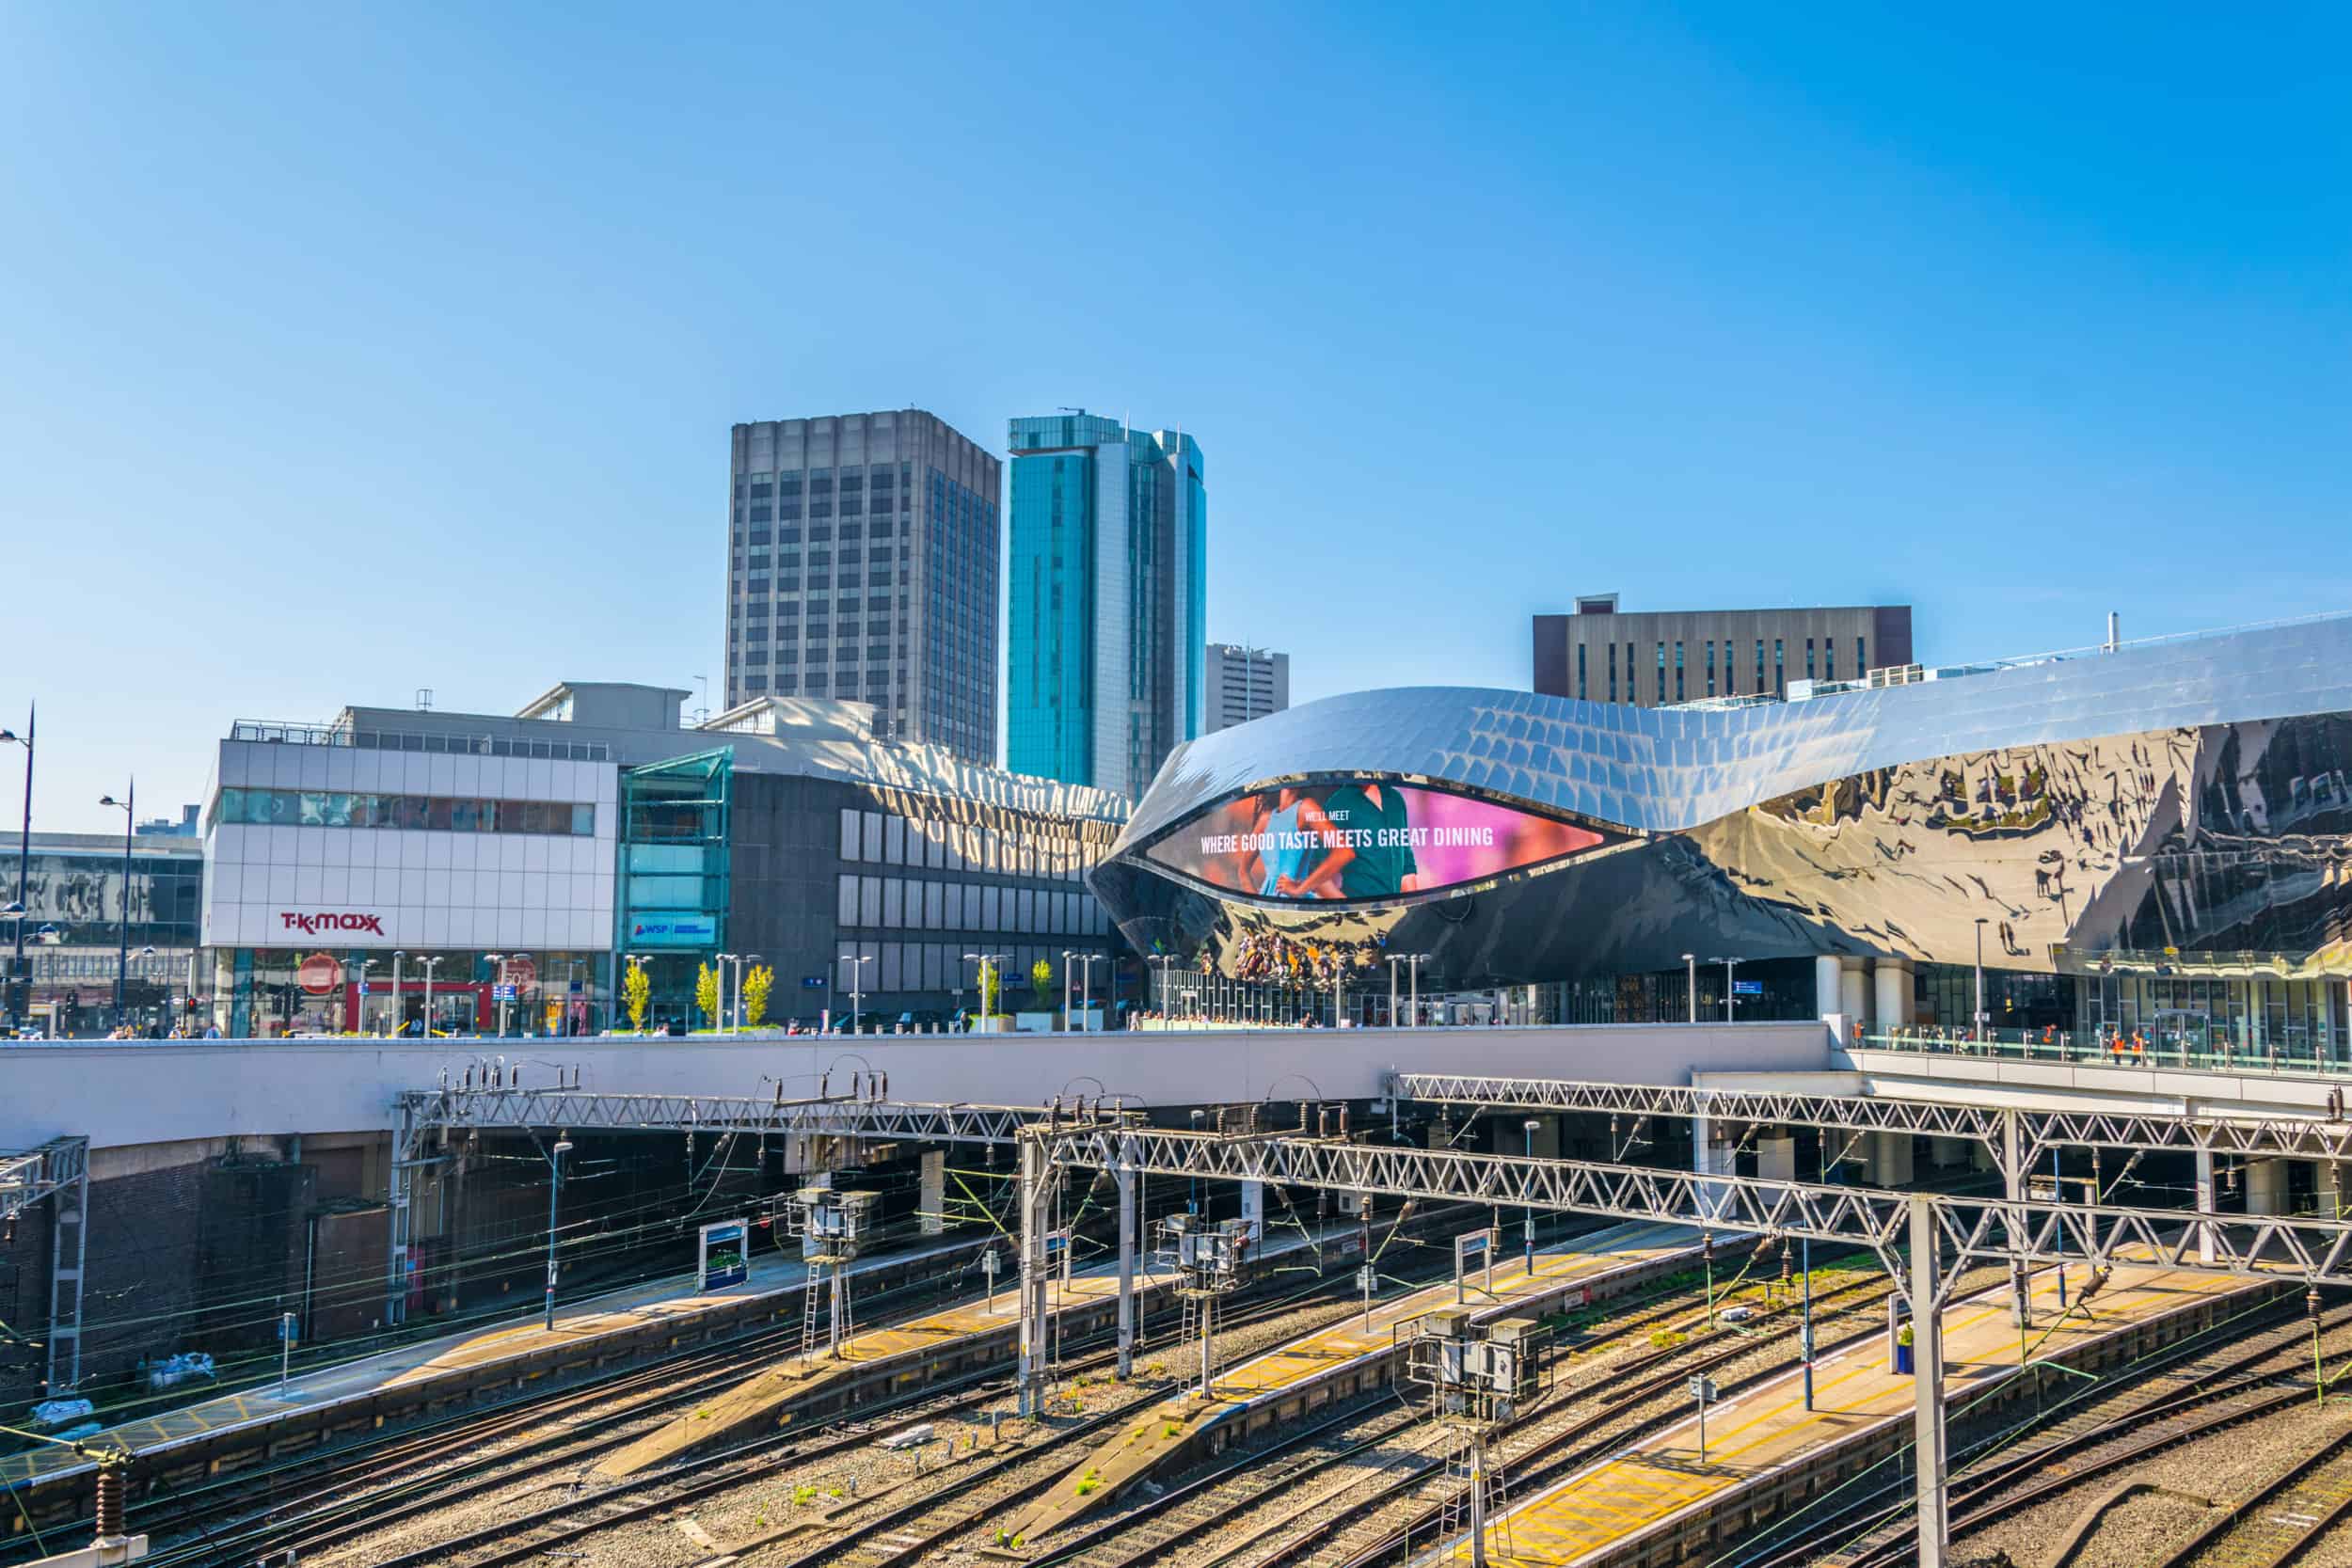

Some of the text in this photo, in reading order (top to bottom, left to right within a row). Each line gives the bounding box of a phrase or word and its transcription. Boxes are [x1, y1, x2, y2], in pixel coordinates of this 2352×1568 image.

[1305, 810, 1349, 822] WE'LL MEET
[1200, 827, 1493, 854] WHERE GOOD TASTE MEETS GREAT DINING
